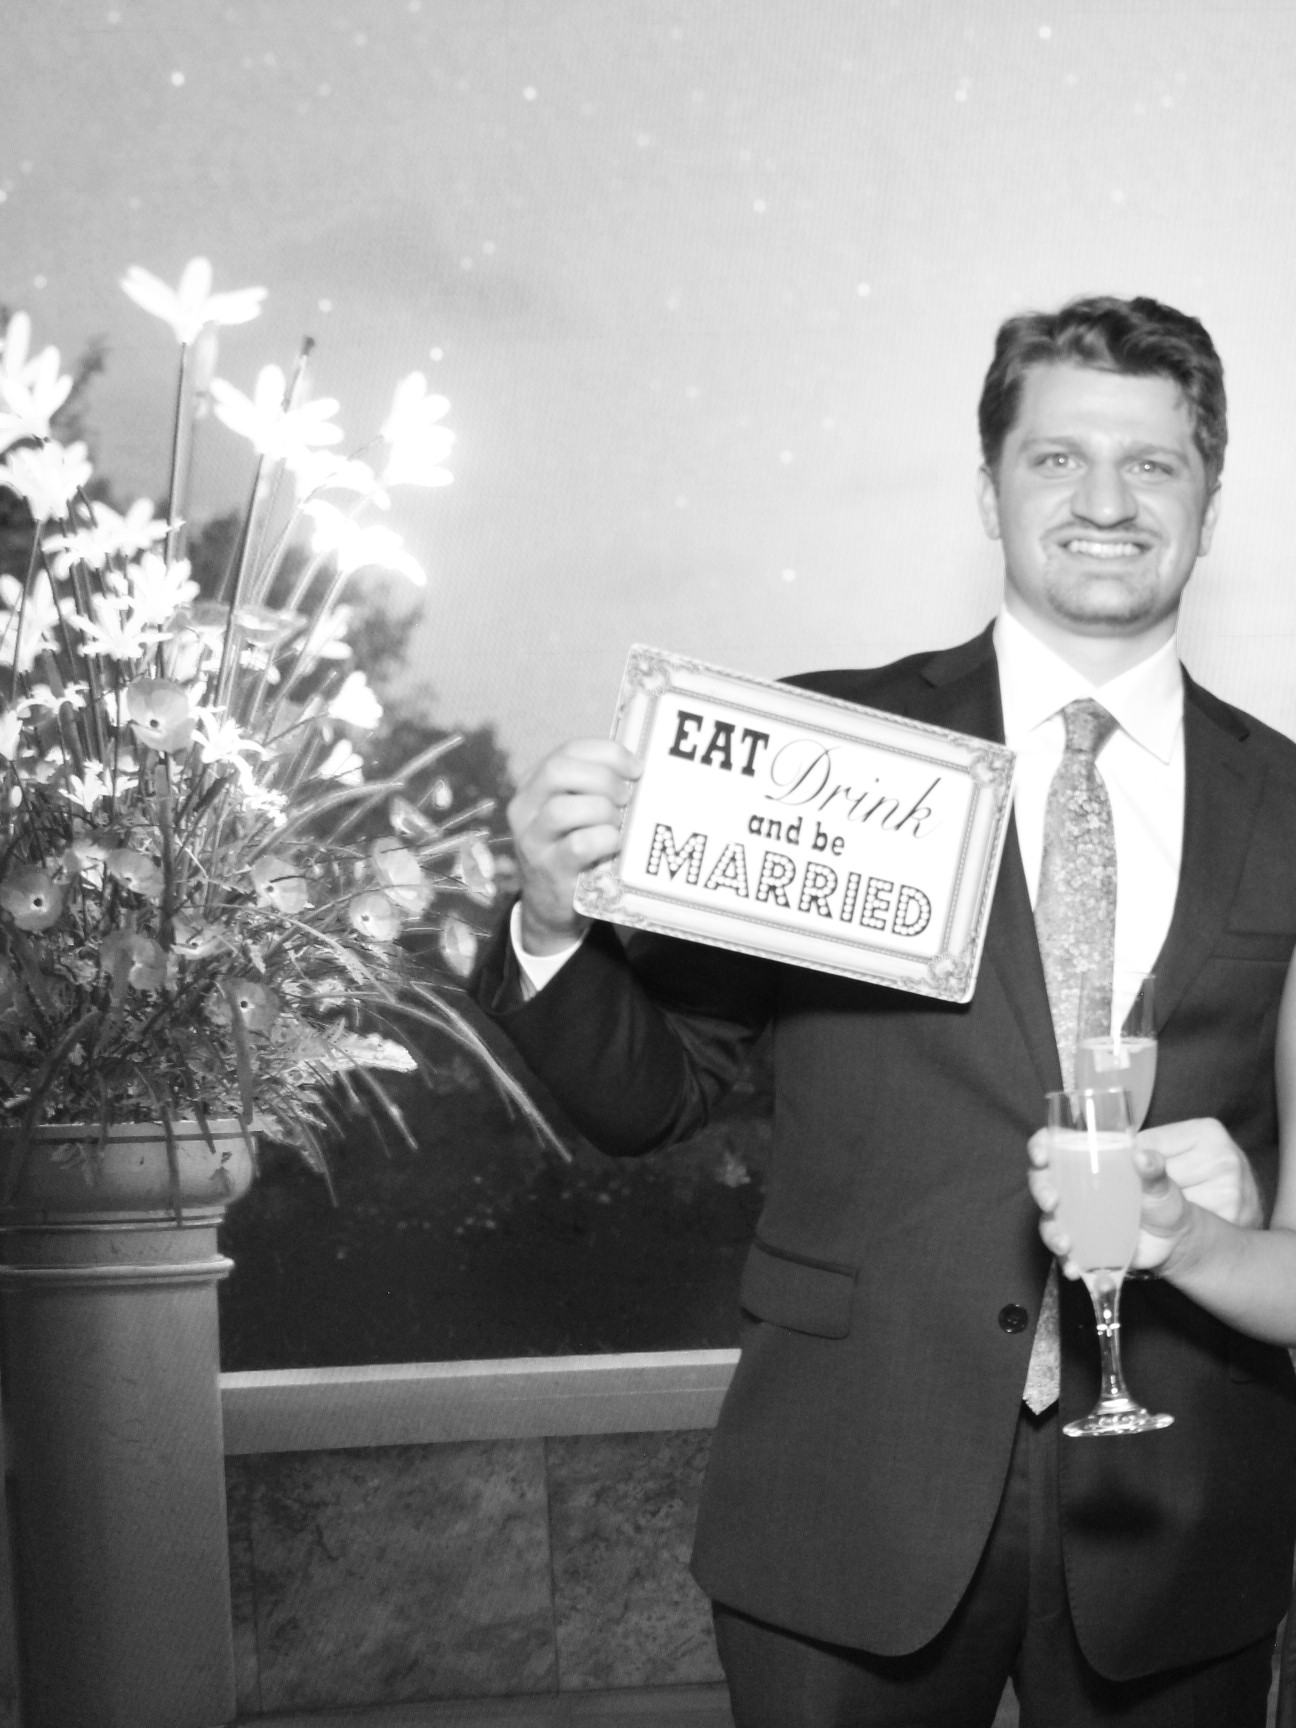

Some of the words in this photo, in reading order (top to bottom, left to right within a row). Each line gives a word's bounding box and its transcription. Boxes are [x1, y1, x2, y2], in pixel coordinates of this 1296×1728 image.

[668, 709, 770, 778] EAT
[764, 738, 943, 839] Drink
[645, 822, 932, 938] MARRIED
[747, 813, 803, 846] and
[811, 821, 846, 856] be
